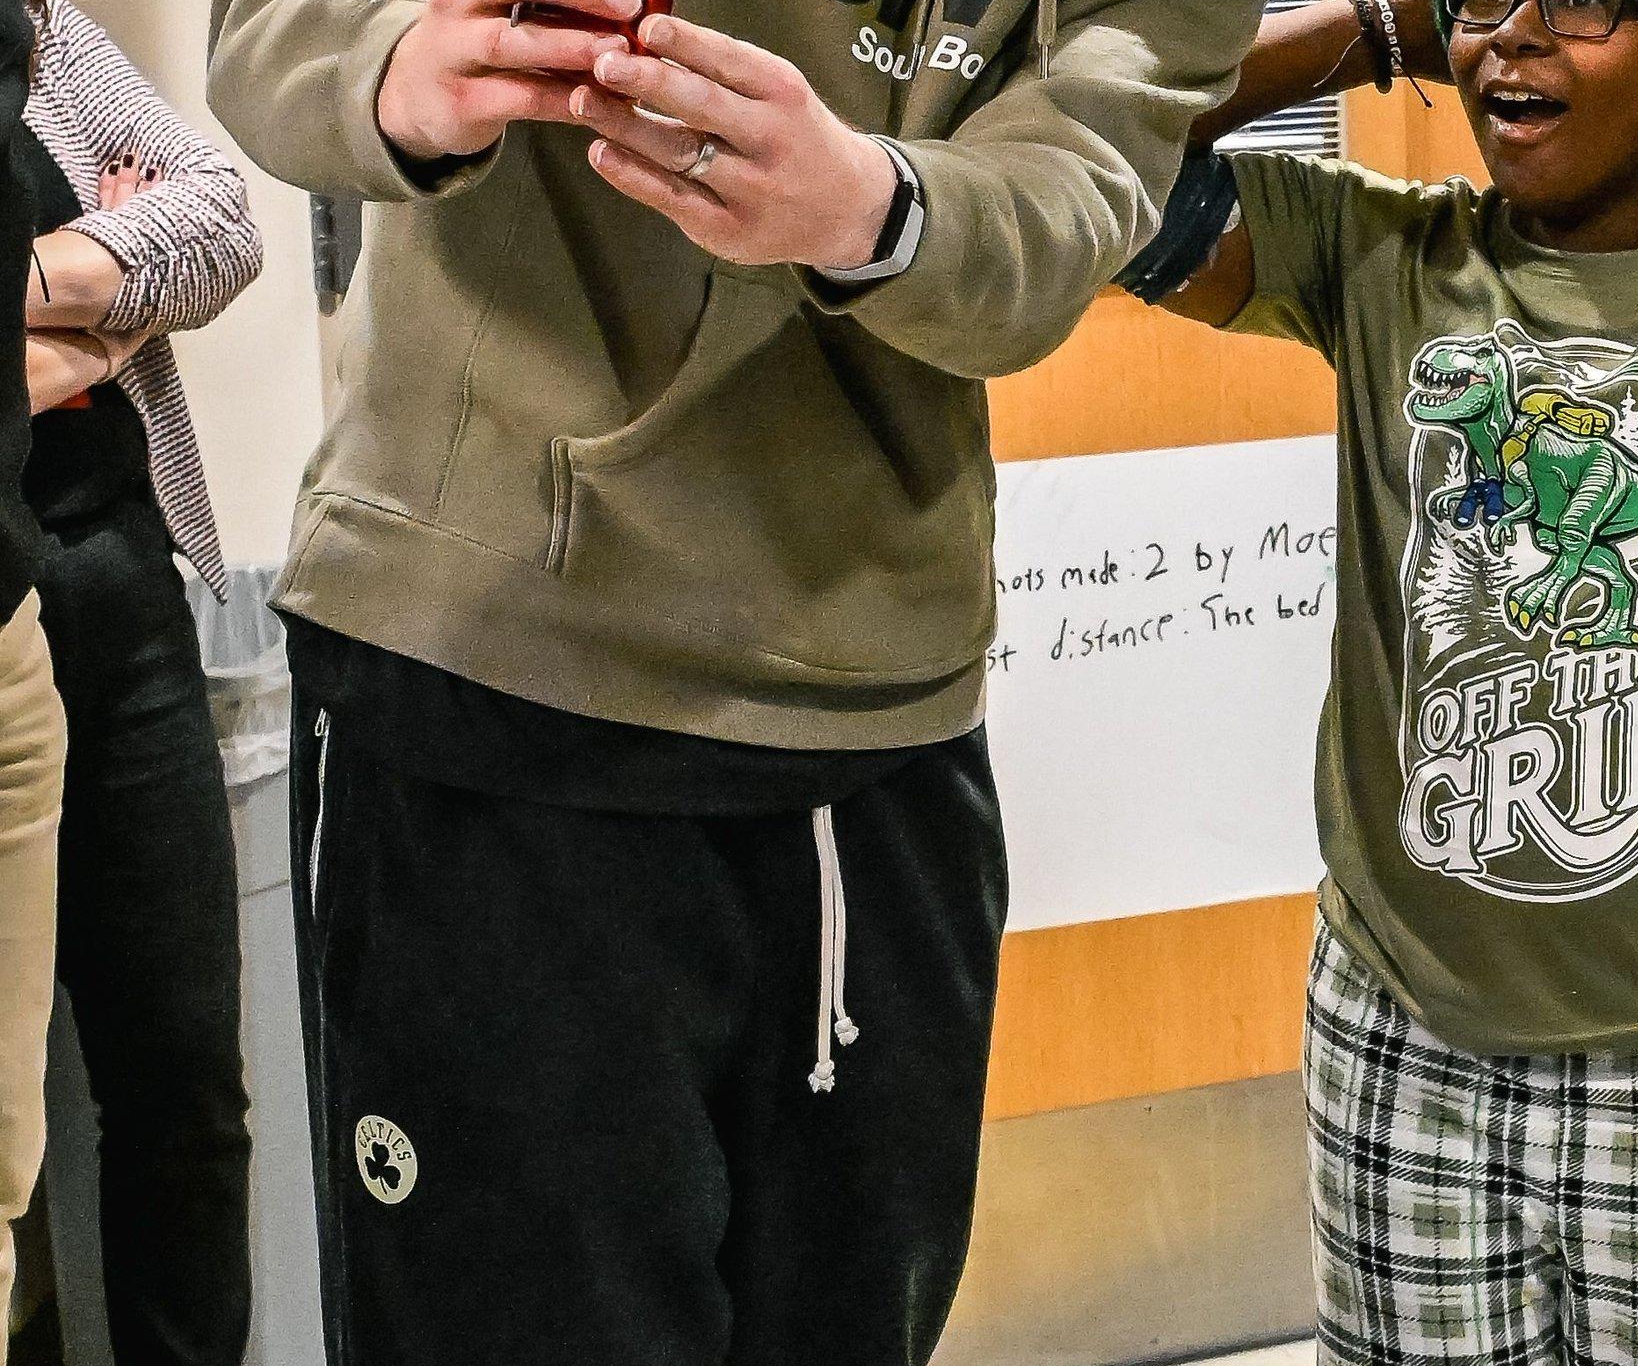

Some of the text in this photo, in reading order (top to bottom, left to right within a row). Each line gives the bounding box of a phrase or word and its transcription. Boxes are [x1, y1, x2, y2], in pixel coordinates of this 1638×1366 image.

[927, 34, 986, 81] Bo
[1145, 542, 1169, 581] 2
[1195, 542, 1234, 584] by
[1200, 593, 1255, 632] The
[1277, 581, 1326, 619] bed
[1419, 662, 1537, 754] OFF
[357, 1120, 412, 1162] CELTICS
